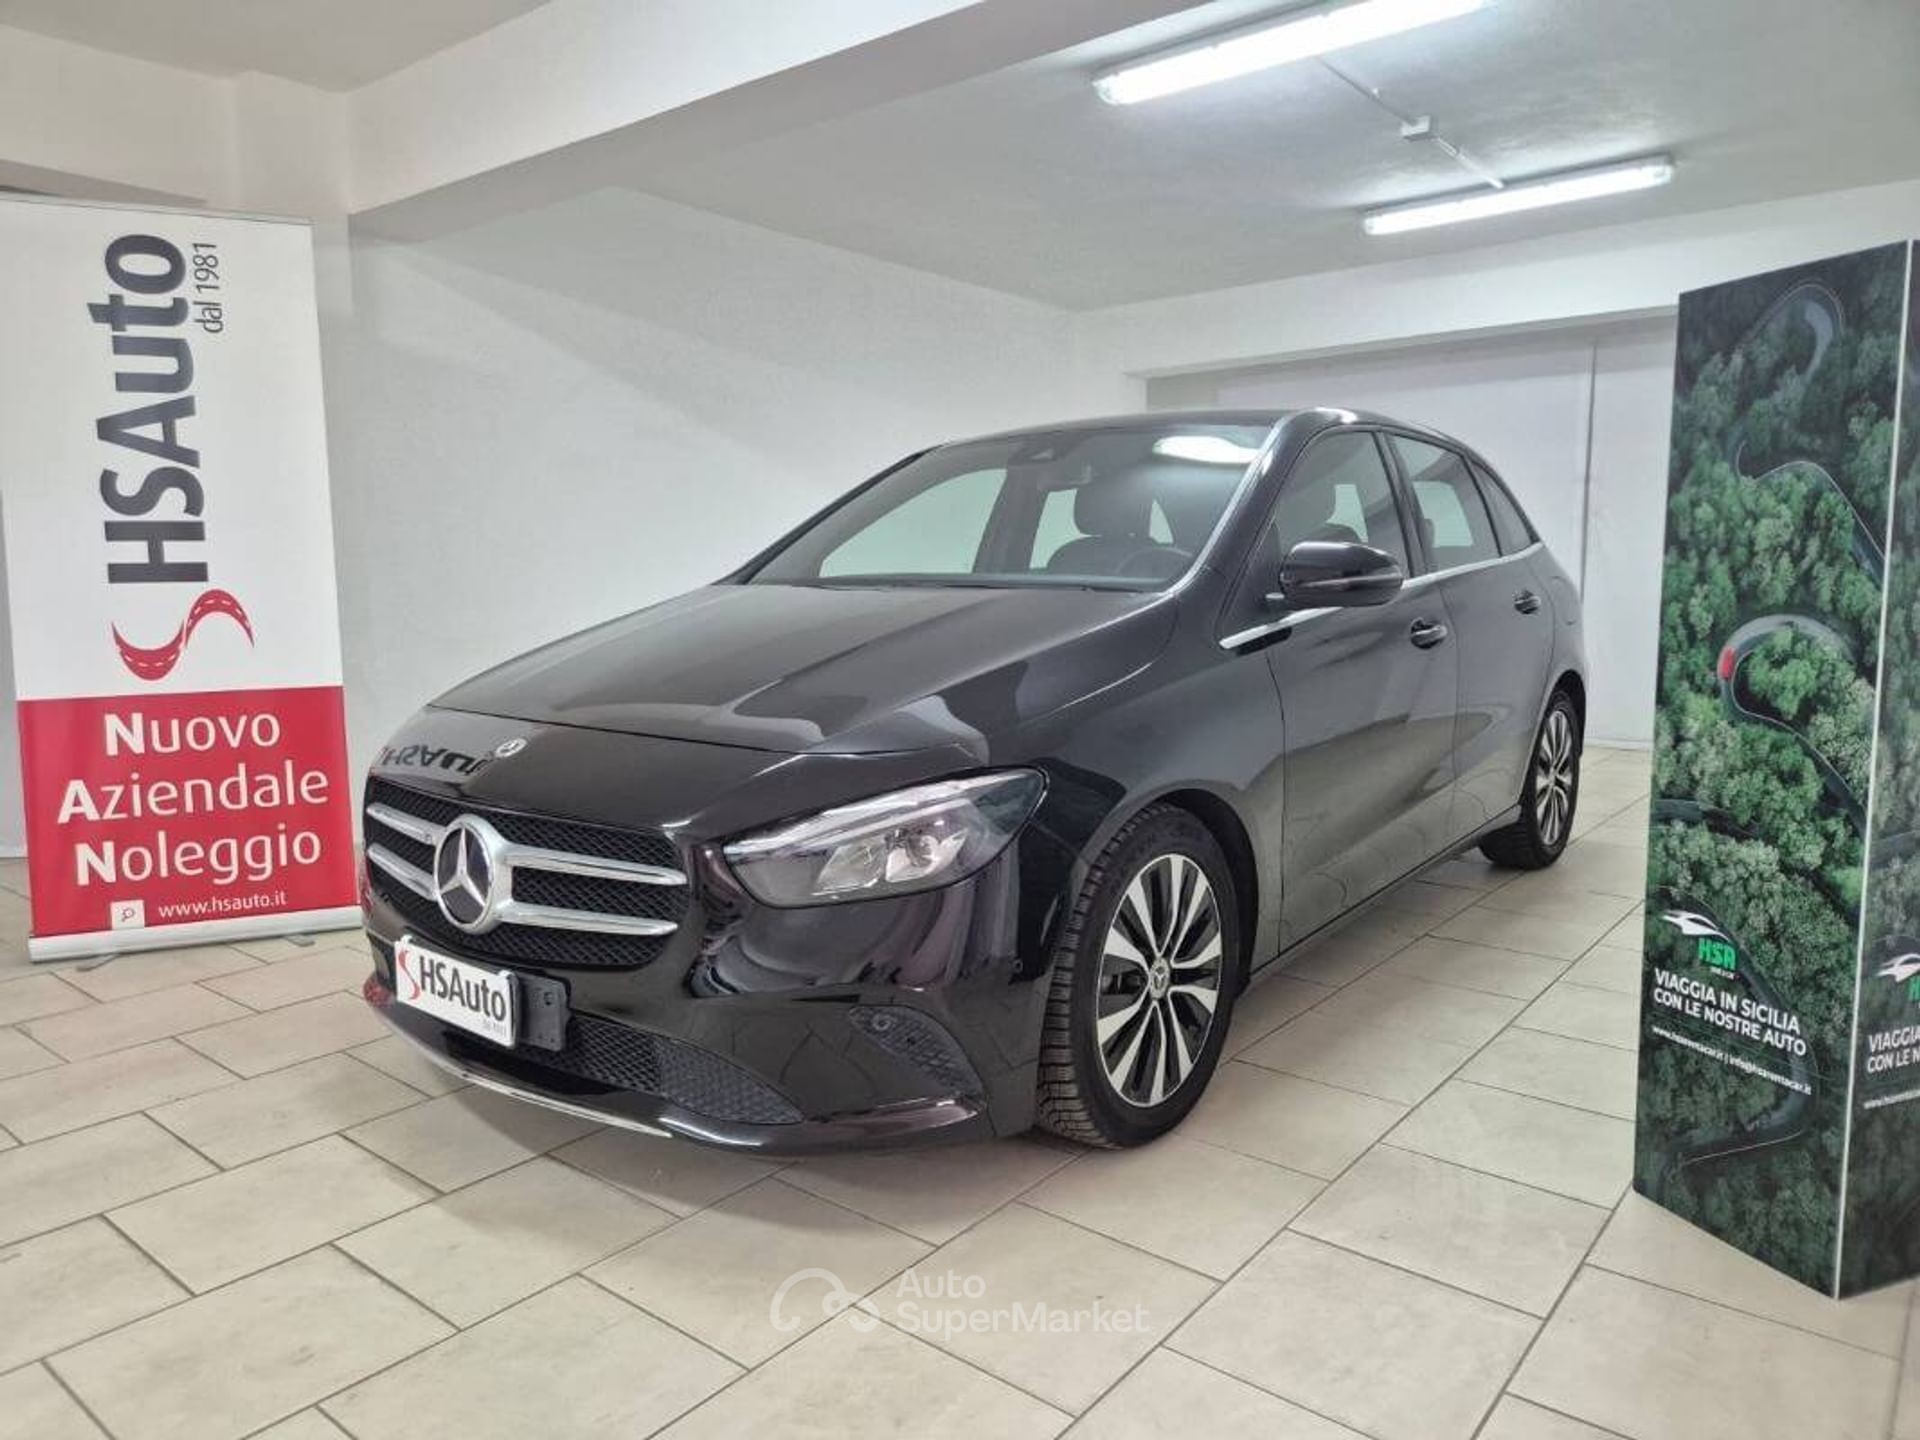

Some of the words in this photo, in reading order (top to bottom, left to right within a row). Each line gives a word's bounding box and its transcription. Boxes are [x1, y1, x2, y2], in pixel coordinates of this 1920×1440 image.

[192, 241, 220, 291] 1981
[193, 299, 223, 333] dal
[87, 234, 208, 584] HSAuto
[104, 712, 281, 756] Nuovo
[57, 759, 329, 824] Aziendale
[74, 822, 322, 886] Noleggio
[158, 890, 287, 918] www.hsauto.it
[1698, 937, 1736, 971] HSA
[419, 954, 507, 1022] HSAuto
[1654, 967, 1717, 1006] VIAGGIA
[1720, 991, 1738, 1013] IN
[1740, 998, 1801, 1035] SICILIA
[1653, 987, 1683, 1011] CON
[1684, 1001, 1702, 1018] LE
[1703, 1008, 1762, 1041] NOSTRE
[1762, 1028, 1807, 1057] AUTO
[1867, 1053, 1894, 1074] CON
[1895, 1048, 1910, 1067] LE
